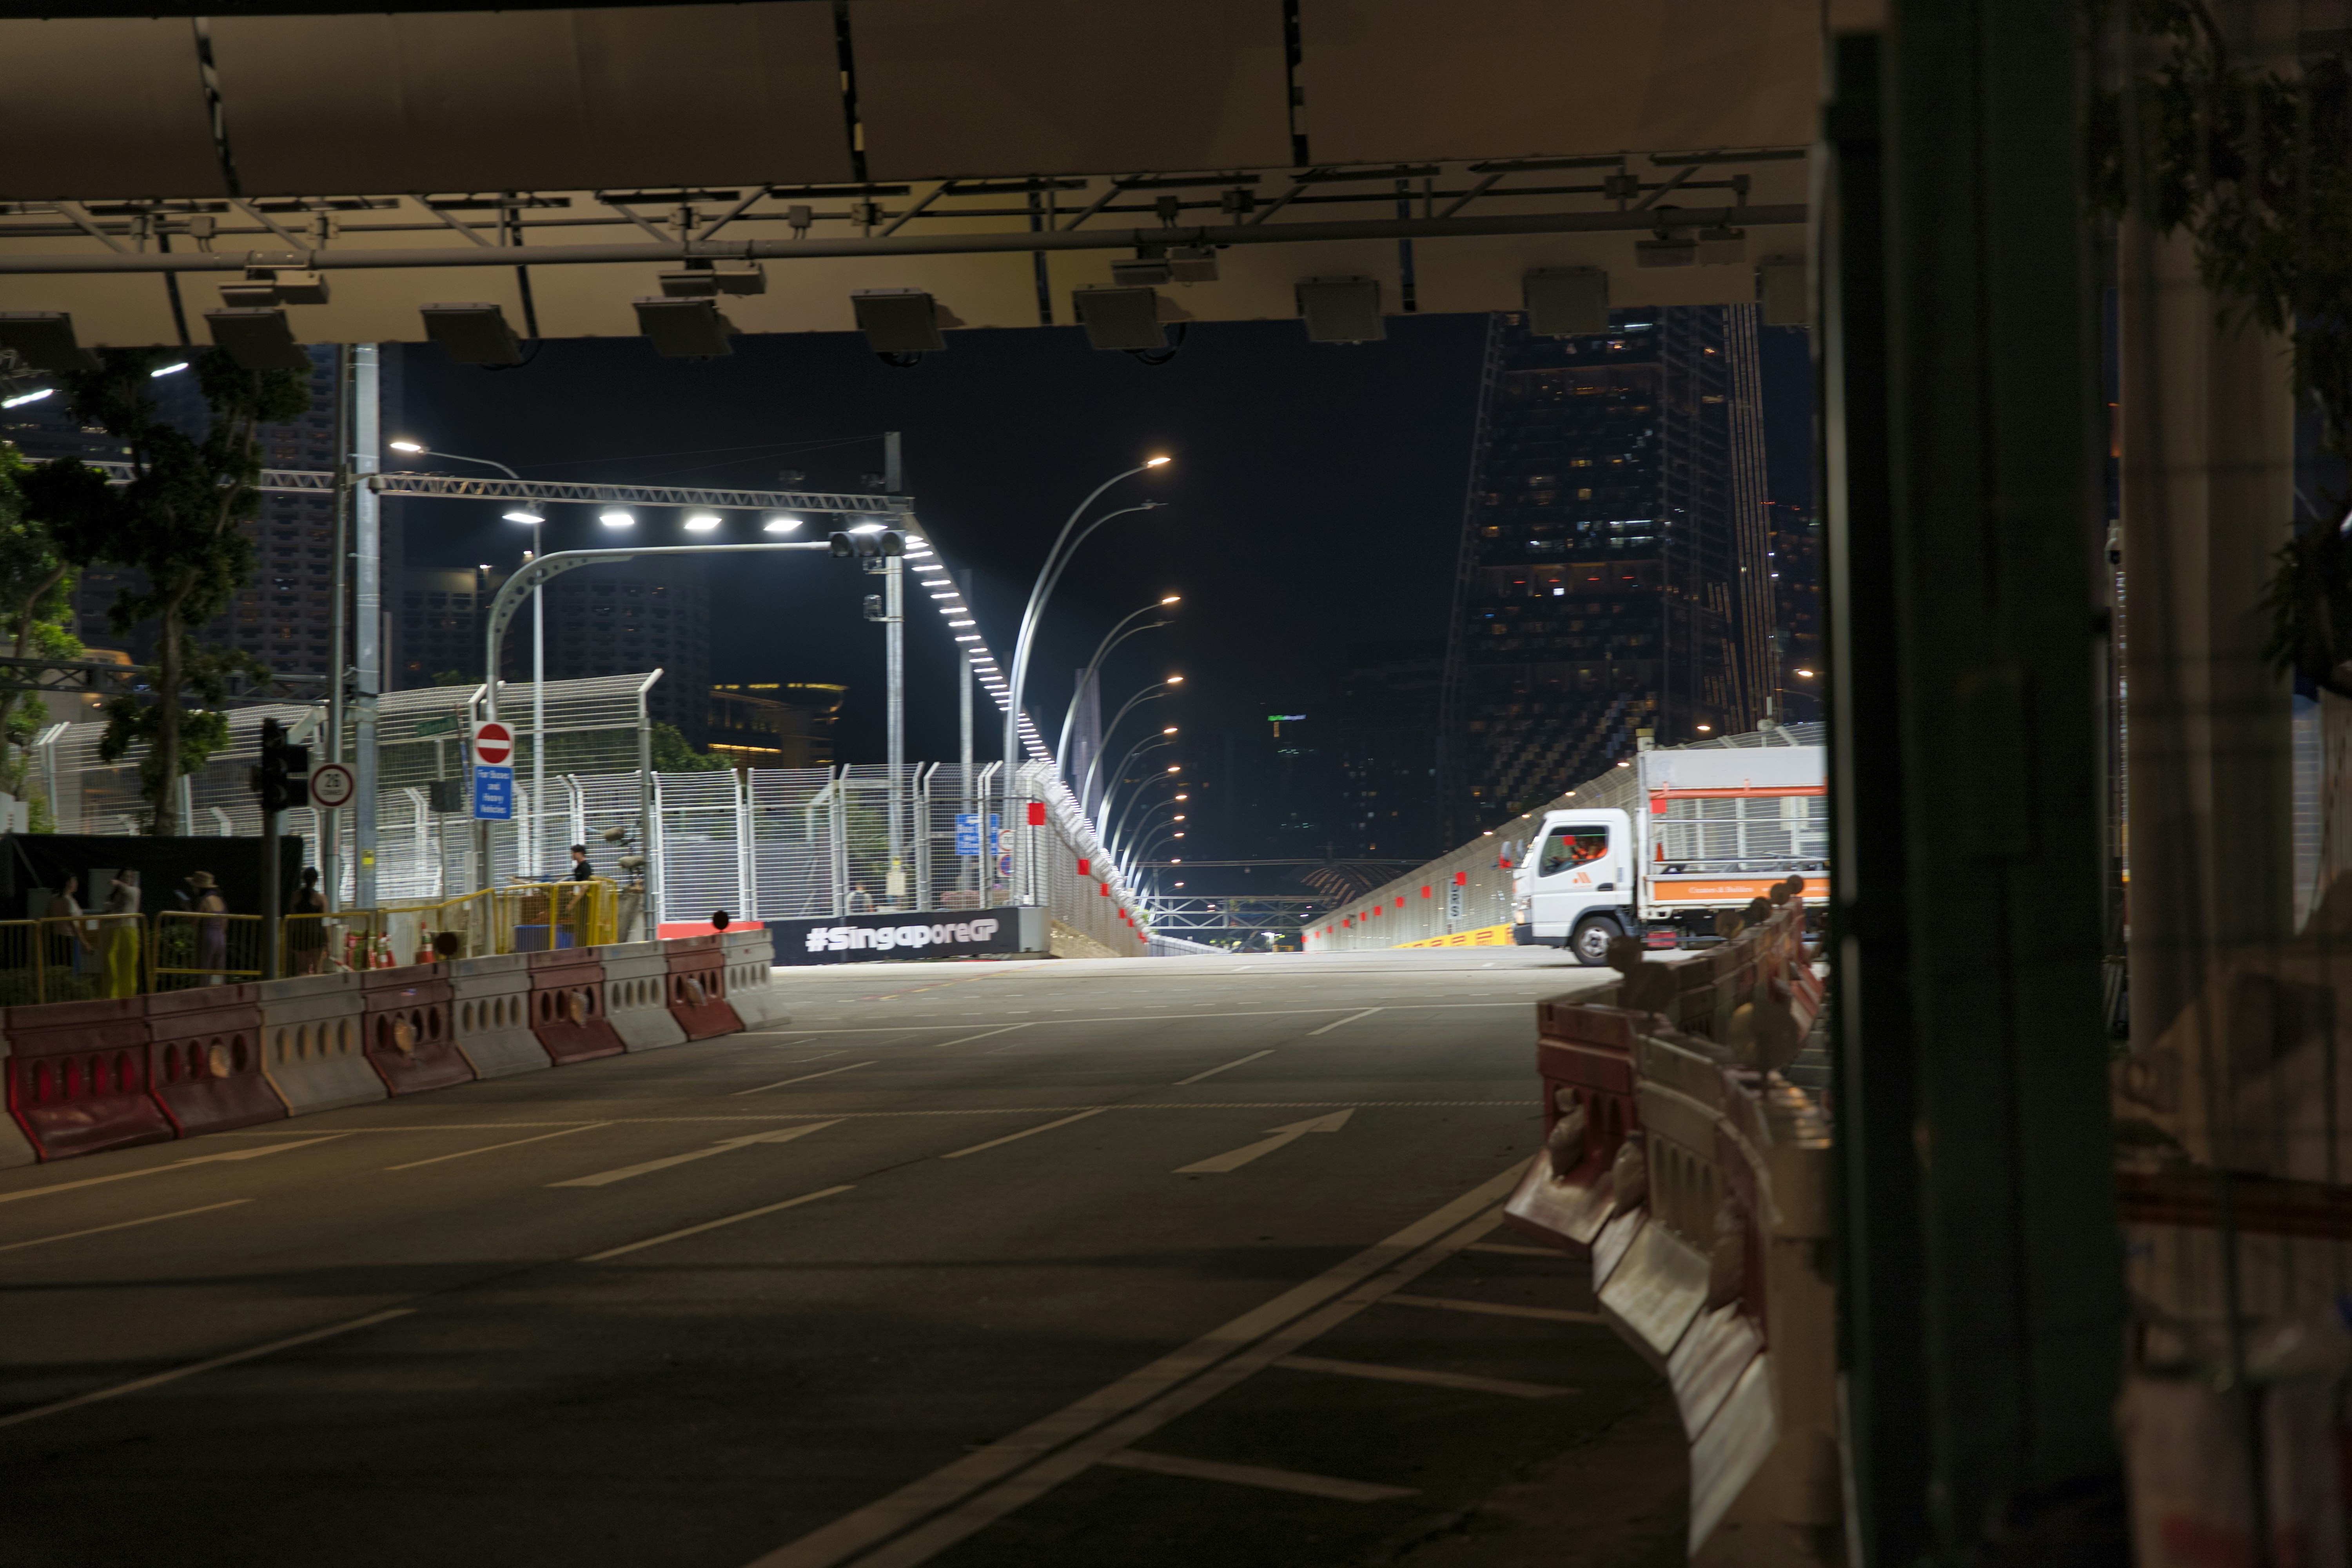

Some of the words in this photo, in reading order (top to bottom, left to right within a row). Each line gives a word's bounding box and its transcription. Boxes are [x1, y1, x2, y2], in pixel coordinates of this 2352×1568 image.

[477, 769, 488, 778] For
[489, 770, 510, 779] Buses
[482, 793, 504, 804] Heavy
[480, 804, 506, 813] Vehicles
[805, 918, 998, 952] #SingaporeGP
